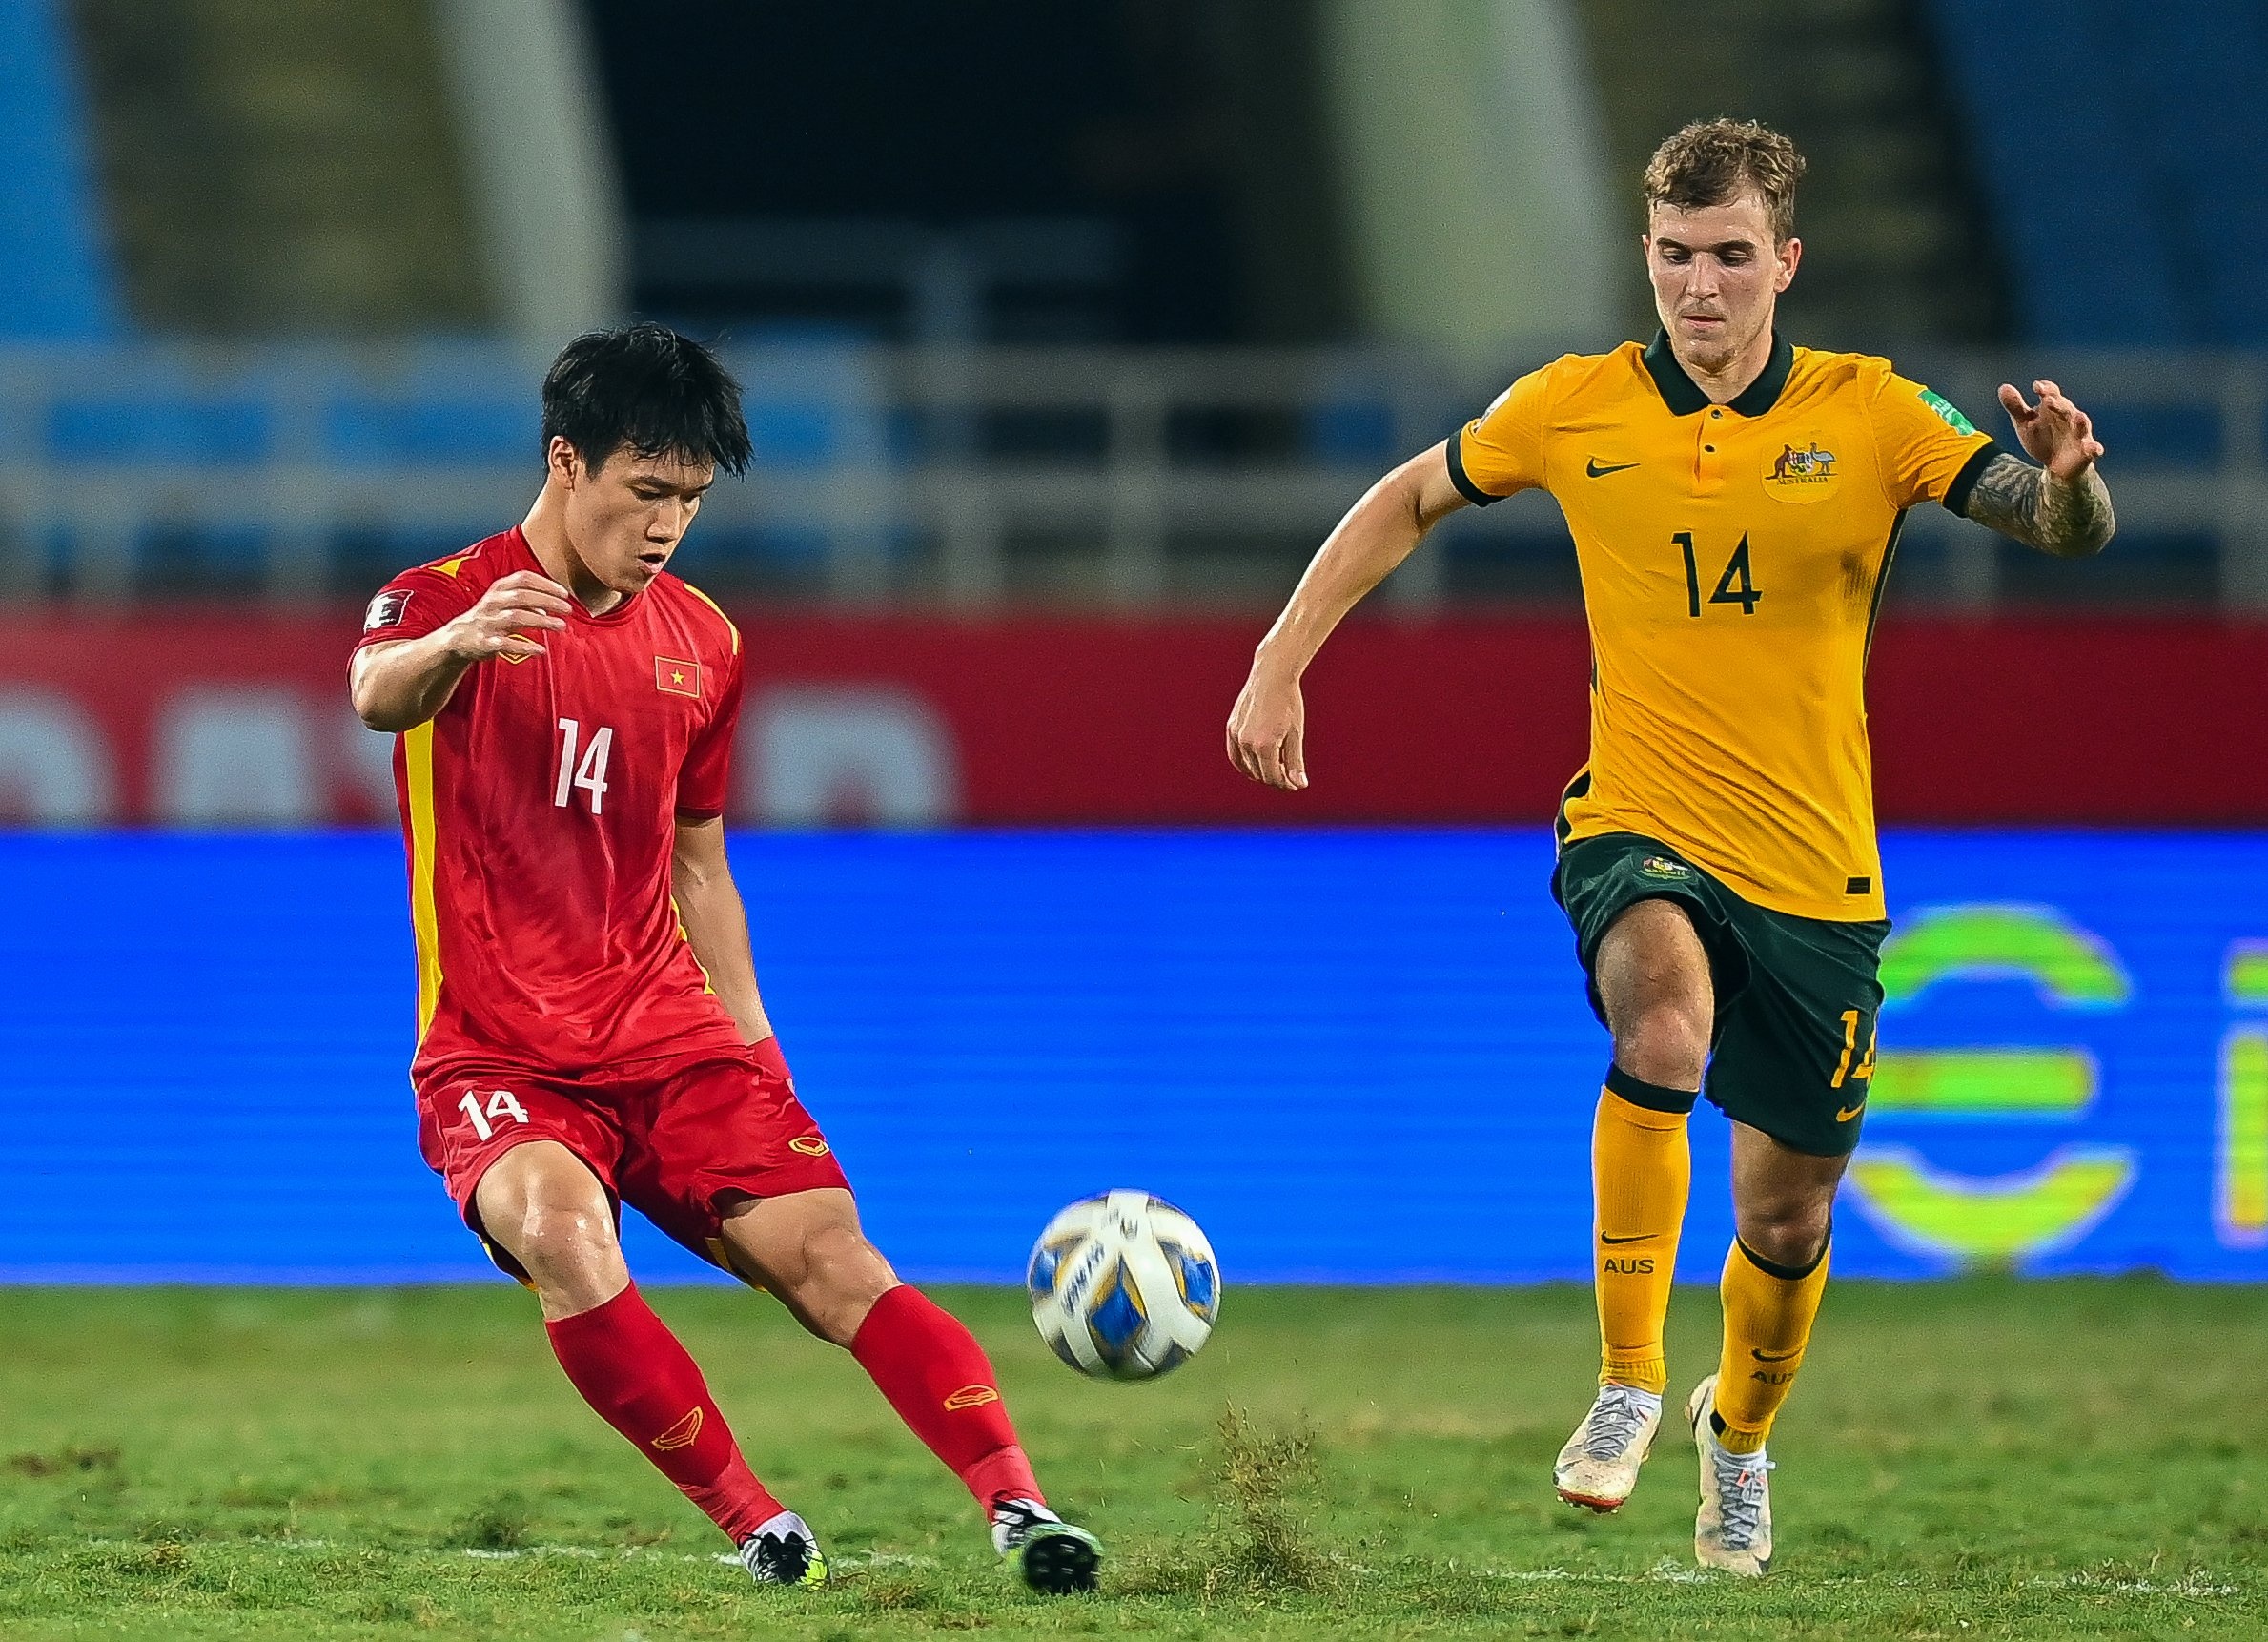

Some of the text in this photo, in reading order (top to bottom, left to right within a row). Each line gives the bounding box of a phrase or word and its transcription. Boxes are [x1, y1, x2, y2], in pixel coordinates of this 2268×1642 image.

[1671, 531, 1763, 618] 14
[554, 718, 613, 814] 14
[458, 1090, 529, 1141] 14
[1604, 1258, 1655, 1275] AUS
